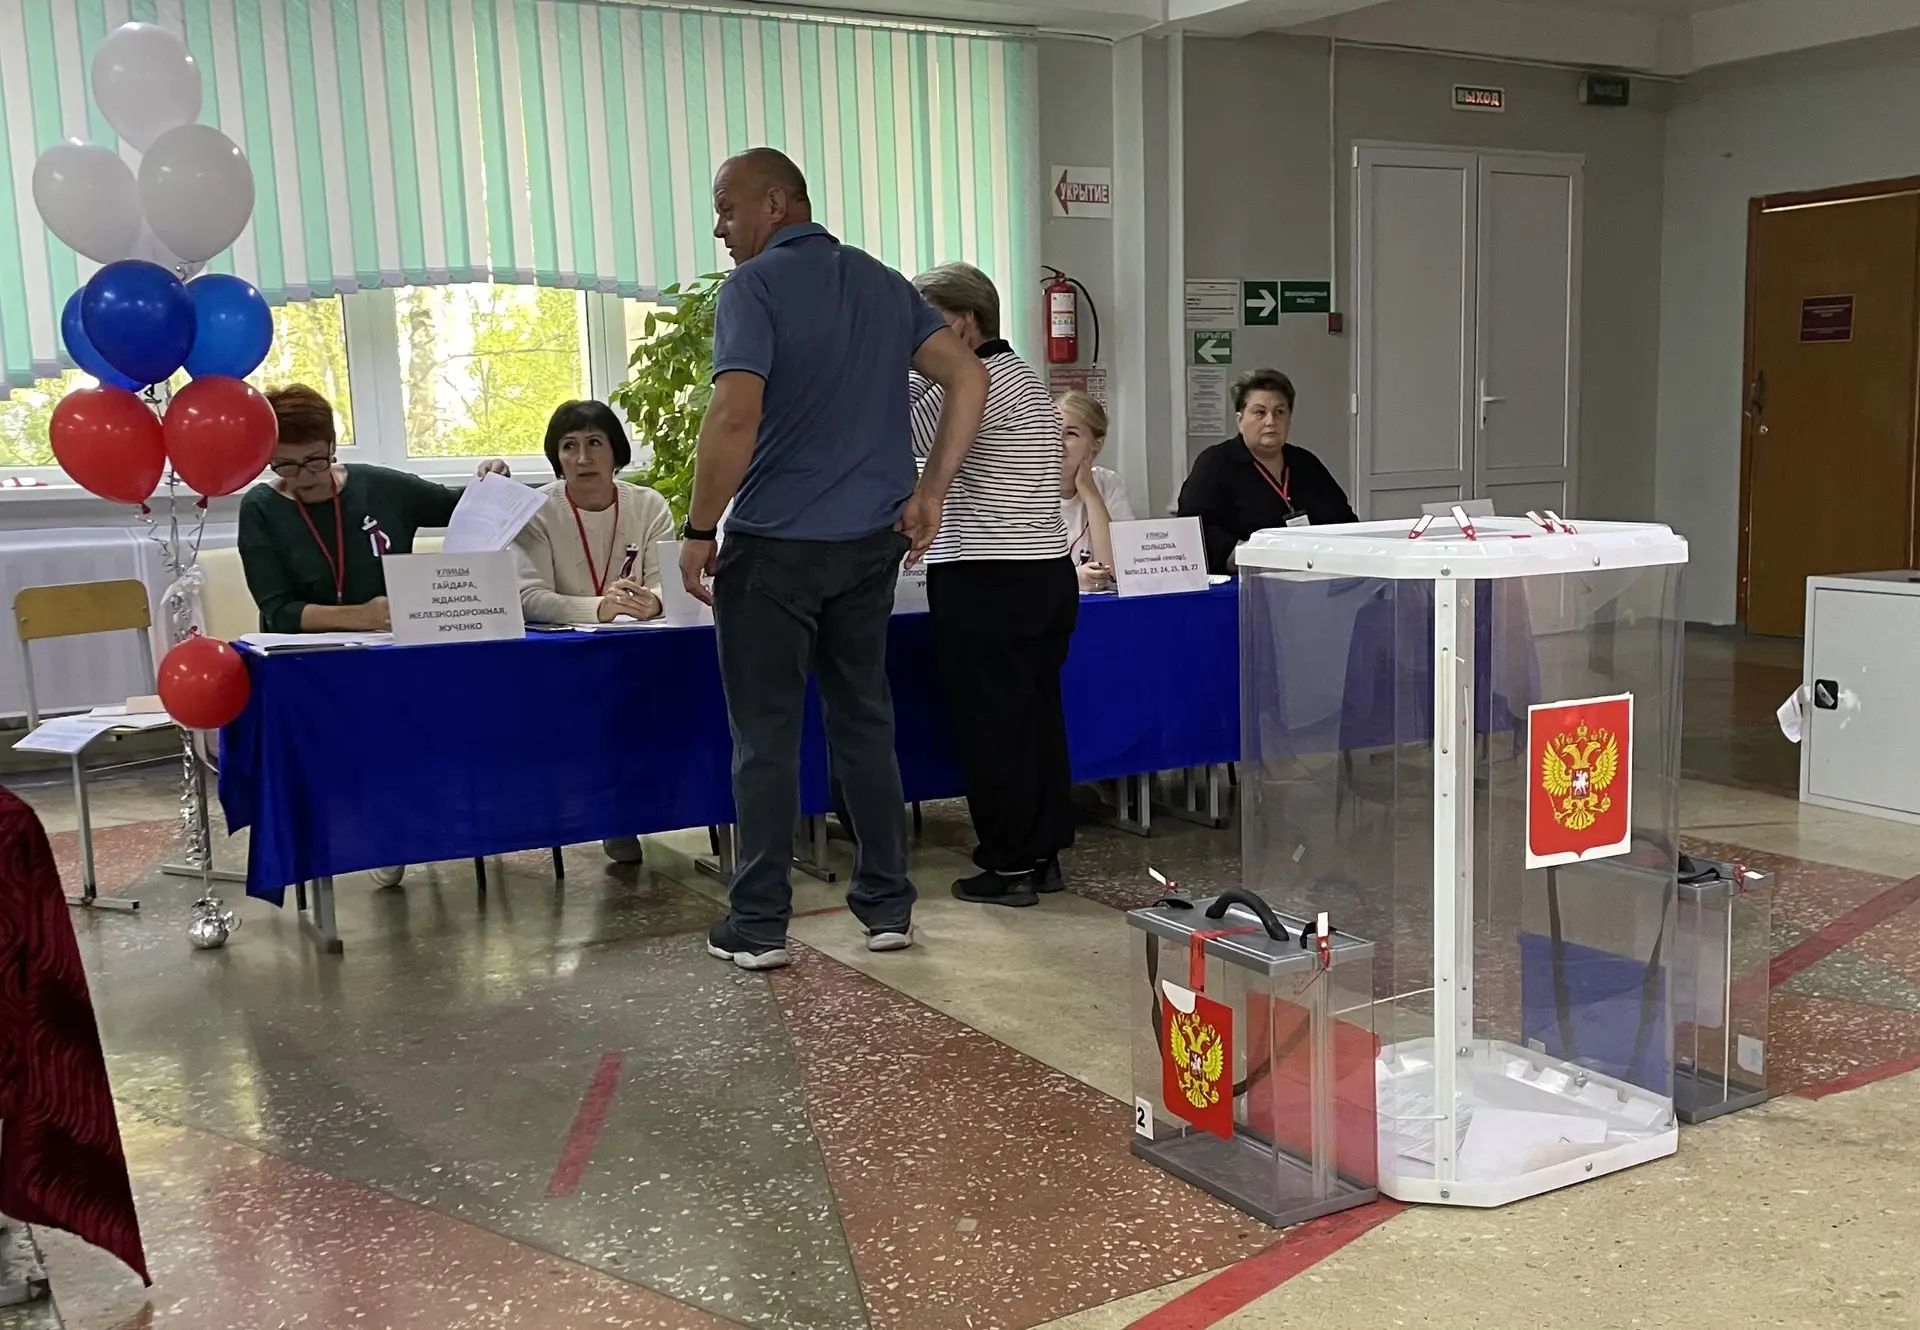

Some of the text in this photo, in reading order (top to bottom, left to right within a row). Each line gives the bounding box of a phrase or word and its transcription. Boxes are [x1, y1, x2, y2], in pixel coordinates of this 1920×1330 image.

[1458, 89, 1499, 106] ВЫХОД
[1060, 183, 1108, 202] УКРЫТИЕ
[1146, 532, 1168, 540] УЛИЦЫ
[1141, 543, 1176, 551] КОЛЬЦОВА
[436, 567, 470, 577] УЛИЦЫ
[432, 581, 478, 590] ГАЙДАРА,
[432, 595, 481, 604] ЖДАНОВА,
[409, 608, 507, 619] ЖЕЛЕЗНОДОРОЖНАЯ,
[438, 622, 482, 632] ЖУЧЕНКО
[1137, 1106, 1146, 1129] 2
